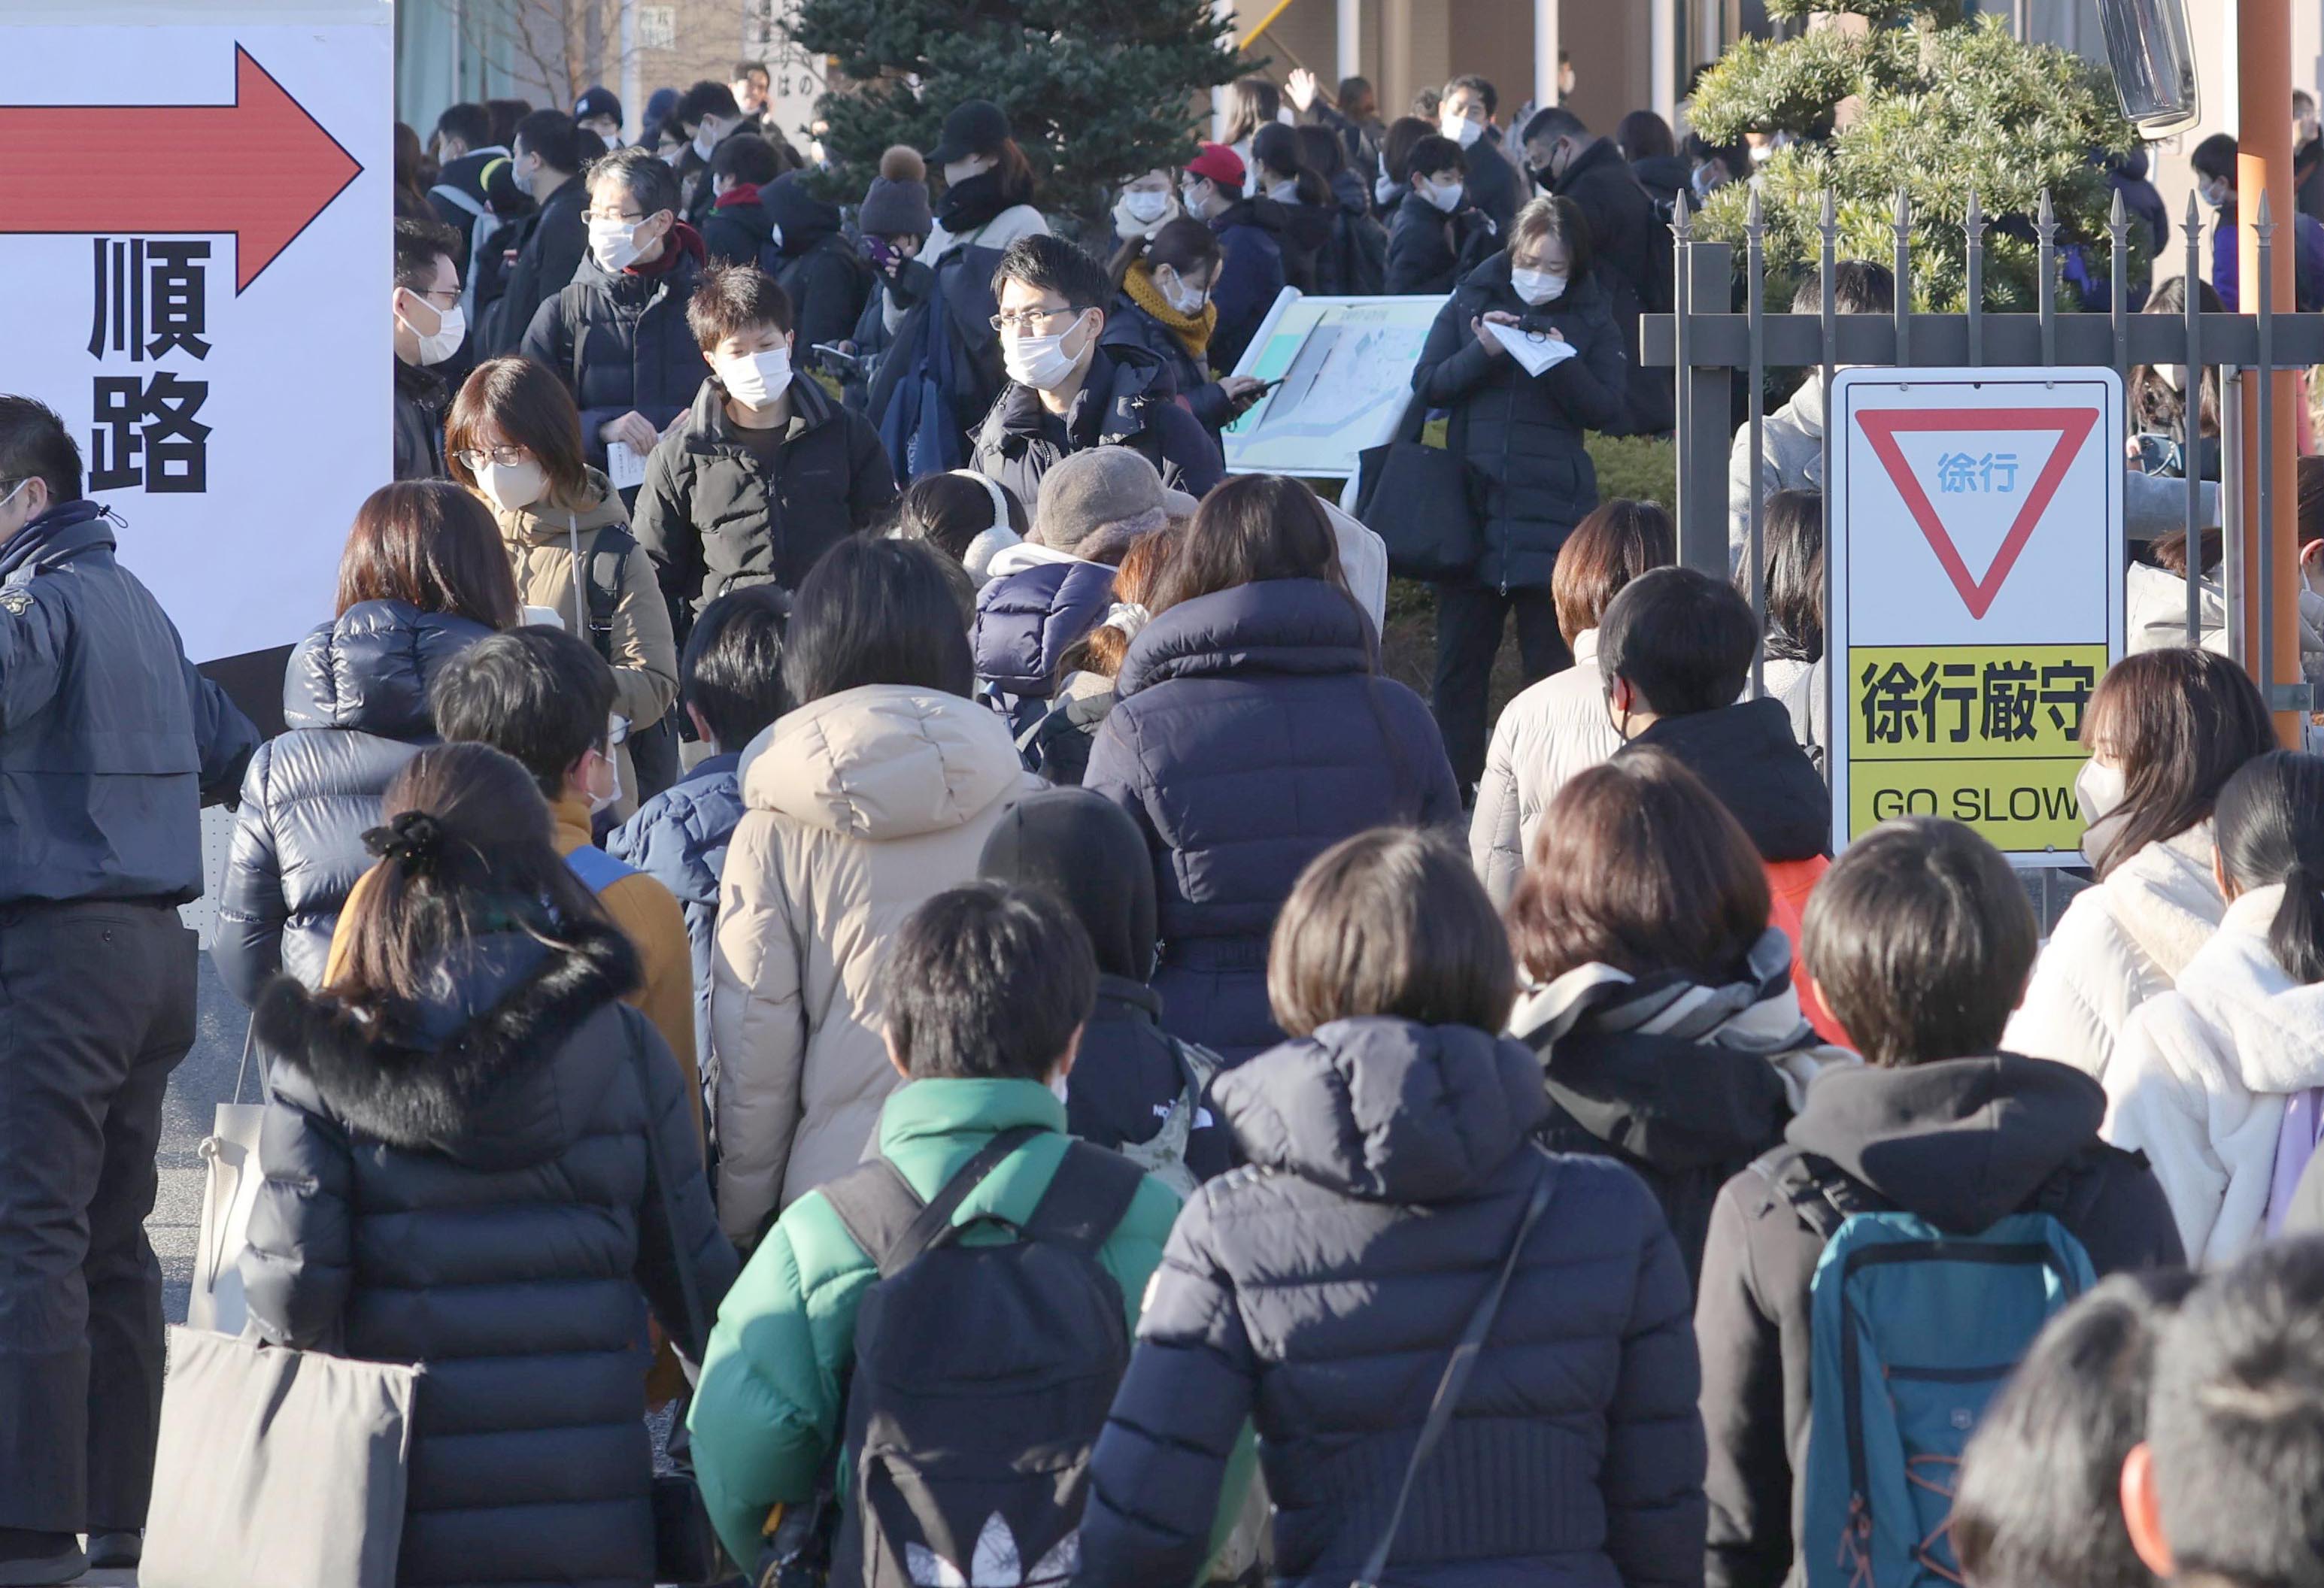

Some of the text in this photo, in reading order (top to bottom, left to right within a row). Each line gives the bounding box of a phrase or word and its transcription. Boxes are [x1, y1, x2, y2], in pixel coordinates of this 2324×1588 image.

[87, 237, 213, 494] 順路
[1937, 452, 2019, 493] 徐行
[1861, 659, 2095, 744] 徐行厳守
[1873, 786, 2078, 823] GO SLOW
